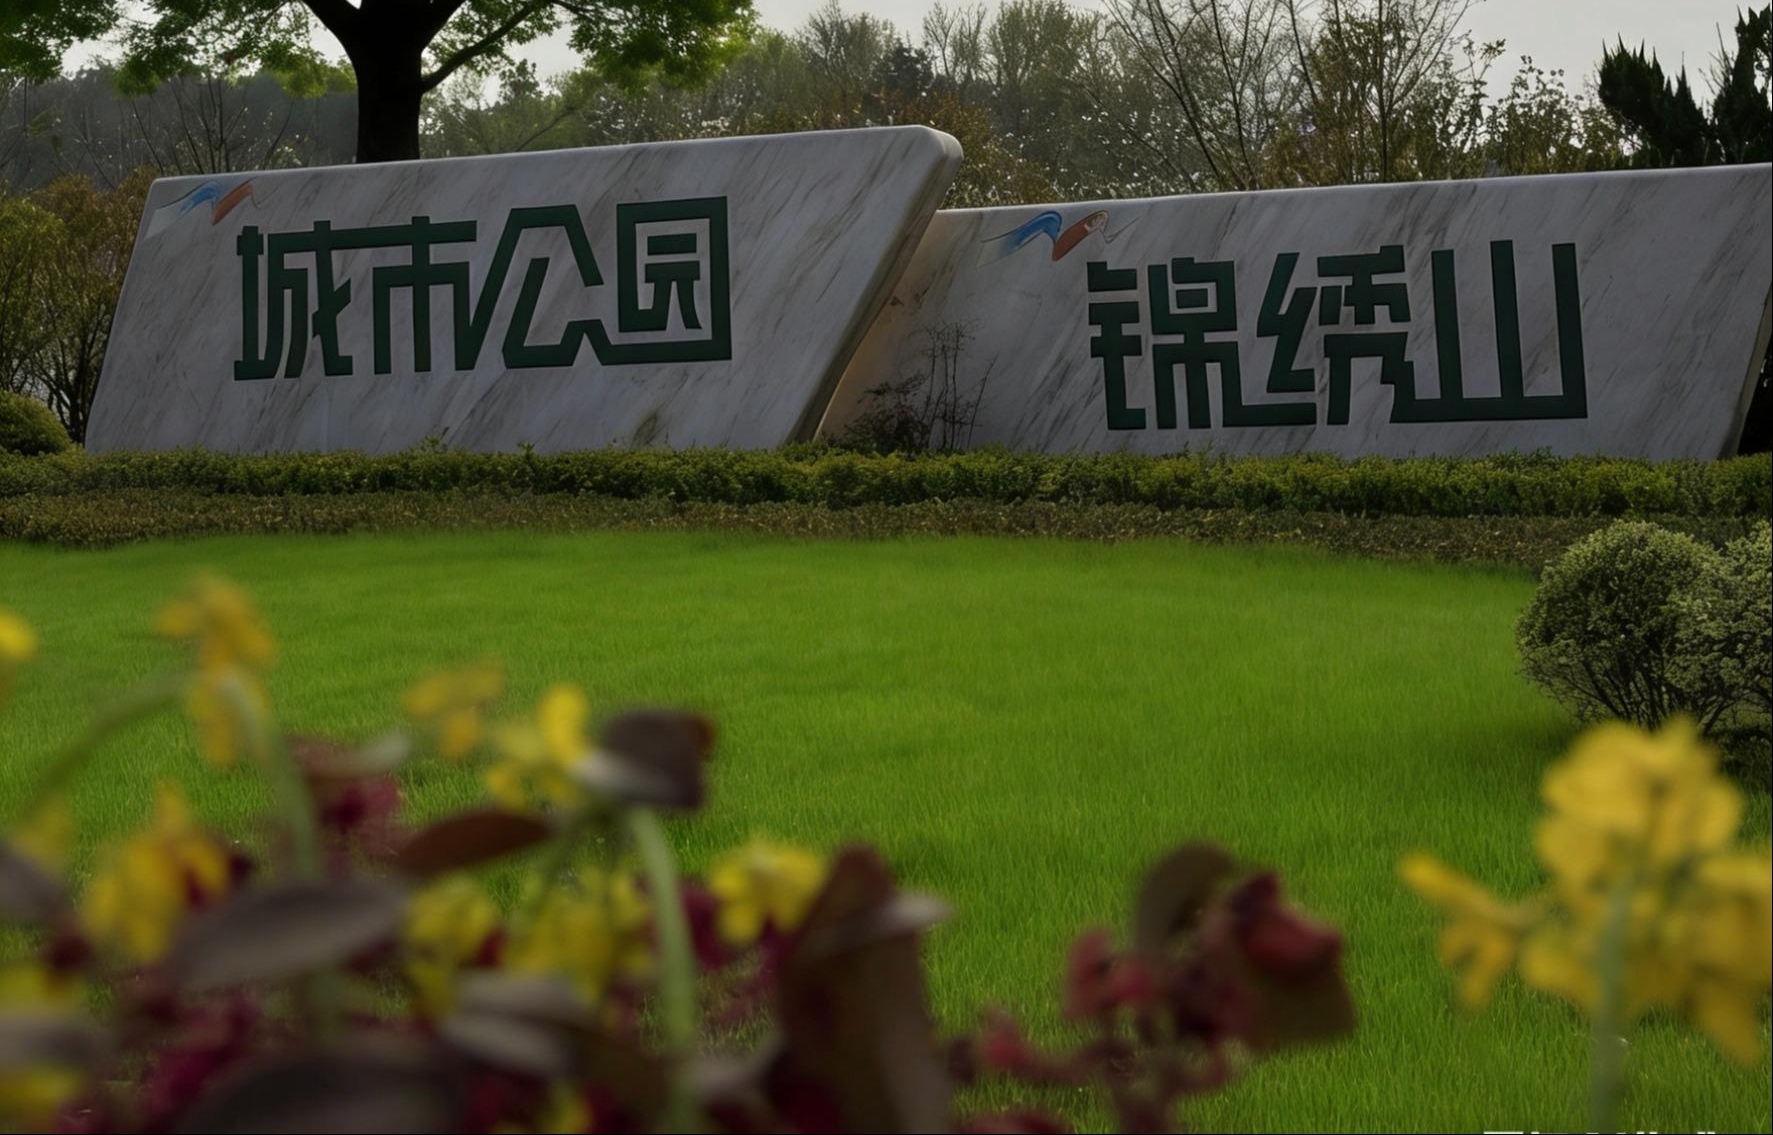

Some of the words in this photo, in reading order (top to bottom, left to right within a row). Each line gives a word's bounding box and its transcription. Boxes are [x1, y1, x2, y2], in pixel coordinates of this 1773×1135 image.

[234, 196, 732, 381] 城市公园
[1087, 239, 1588, 431] 锦绣山
